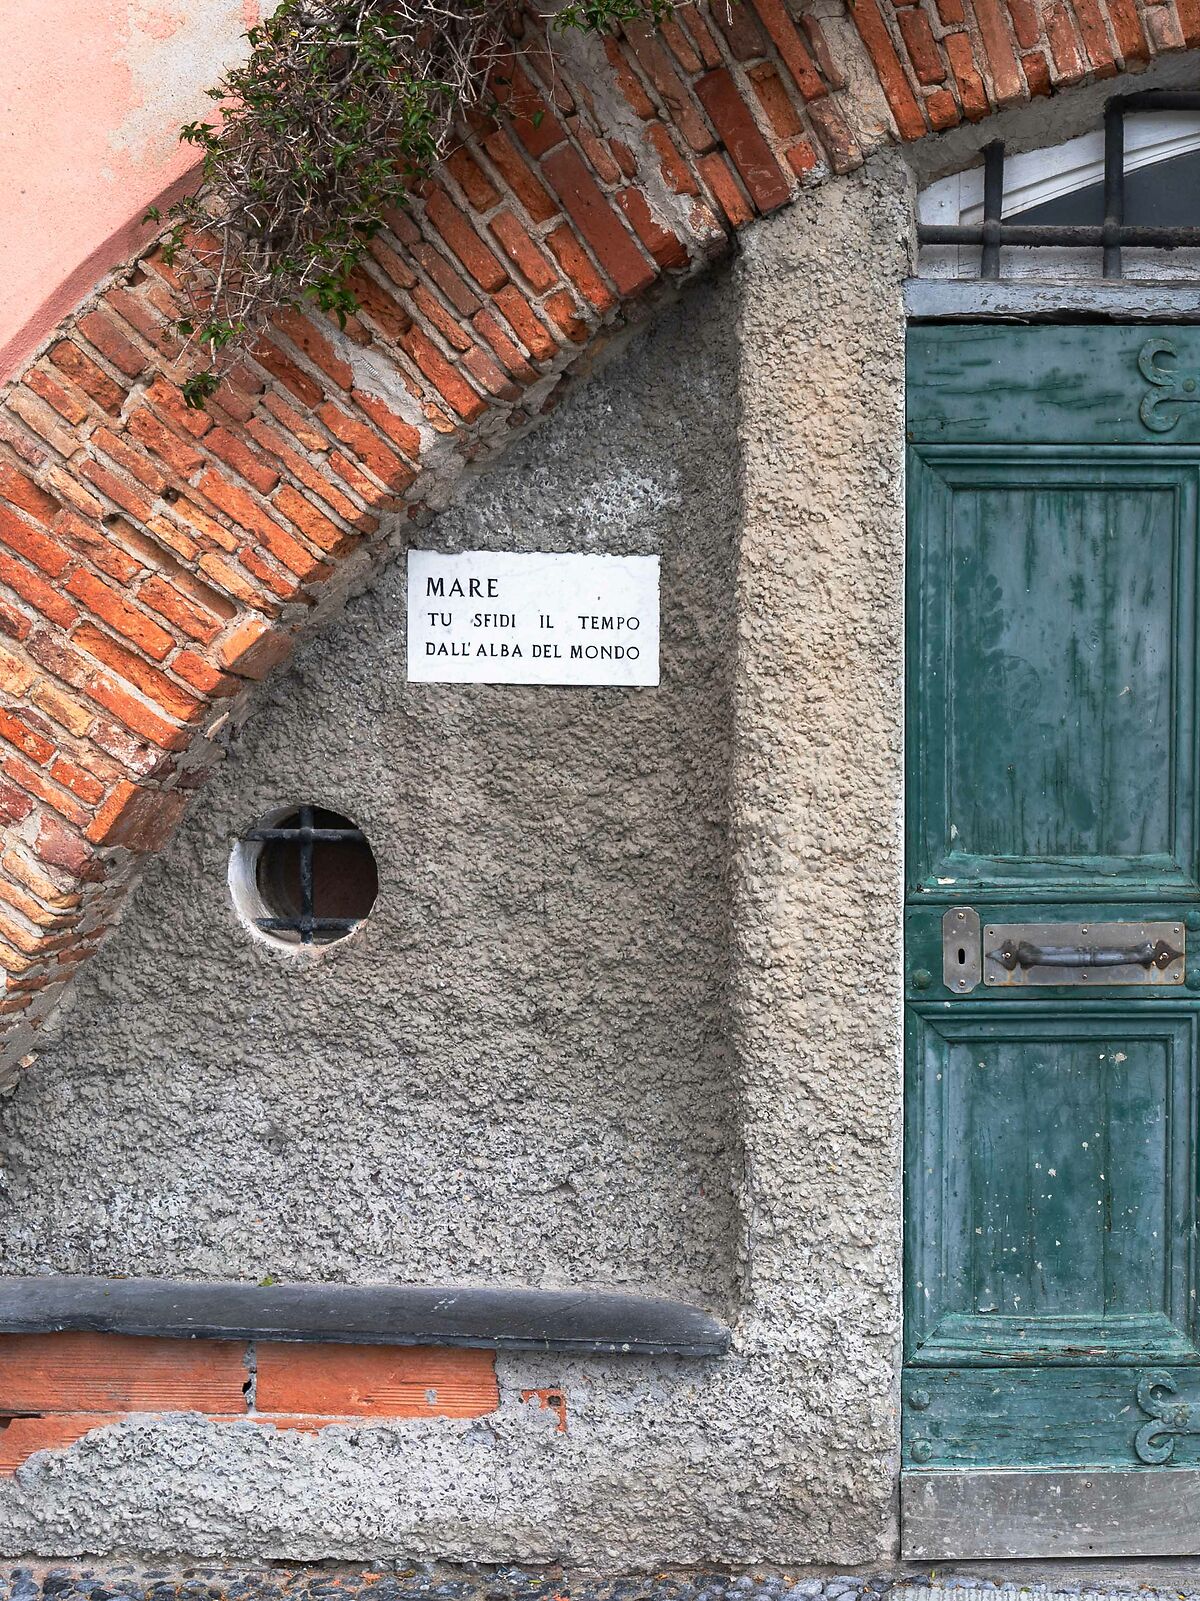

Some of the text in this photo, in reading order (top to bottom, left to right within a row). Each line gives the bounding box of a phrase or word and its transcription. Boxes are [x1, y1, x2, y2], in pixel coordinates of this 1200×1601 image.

[426, 577, 499, 598] MARE
[428, 612, 640, 630] TU SFIDI IL TEMPO
[532, 644, 562, 658] DEL
[570, 645, 640, 660] MONDO
